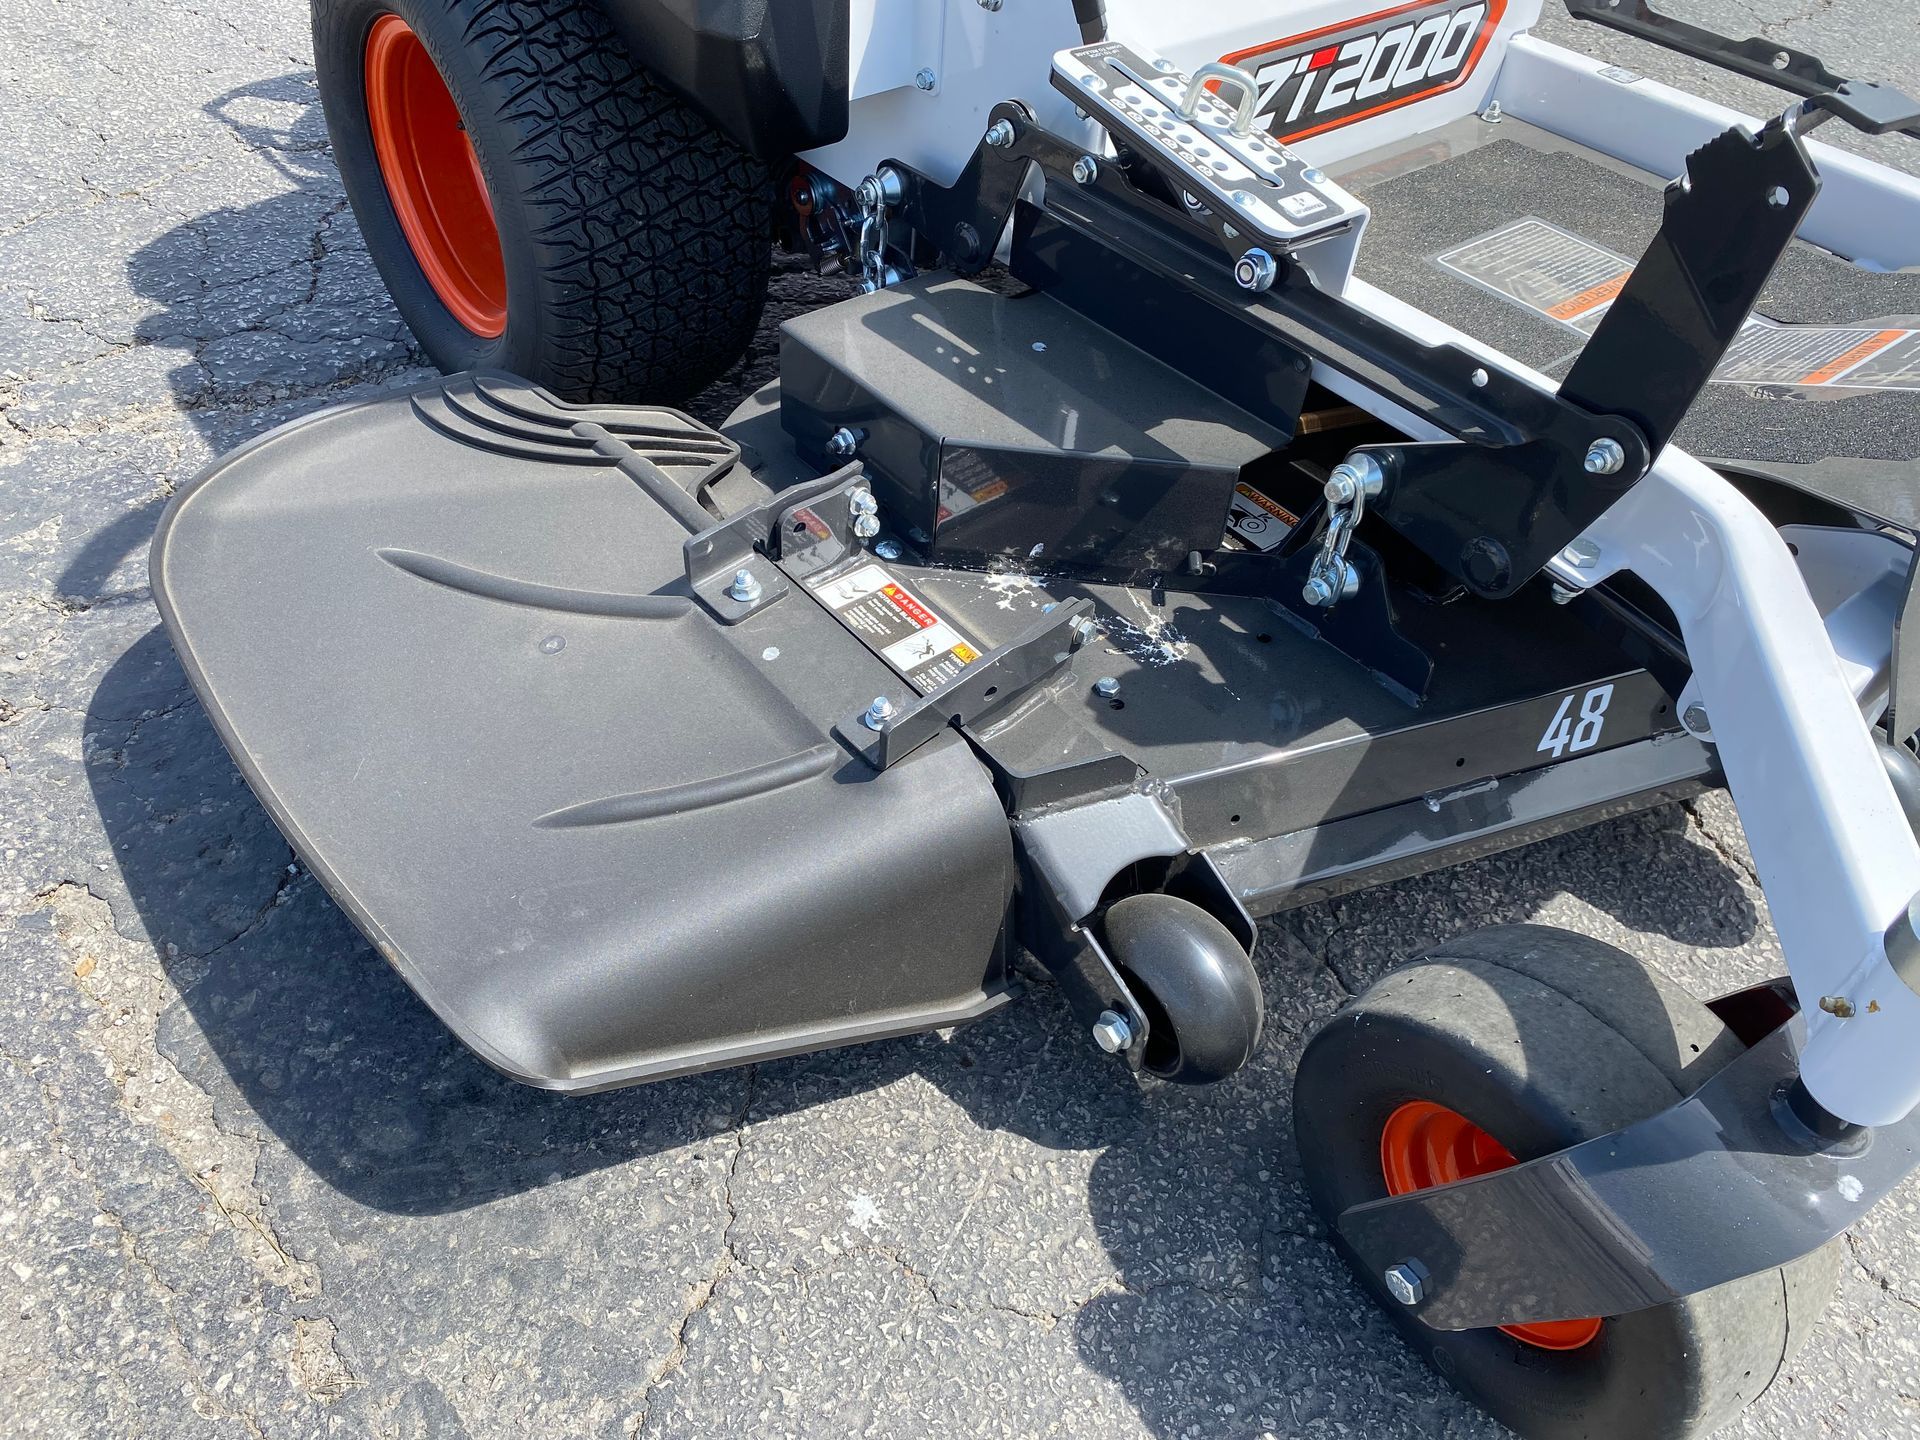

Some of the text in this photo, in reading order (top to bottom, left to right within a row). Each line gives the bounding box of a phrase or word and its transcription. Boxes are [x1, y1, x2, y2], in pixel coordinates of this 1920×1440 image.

[875, 590, 922, 630] ROTATING BLADES
[894, 593, 933, 625] DANGER
[1536, 684, 1614, 758] 48
